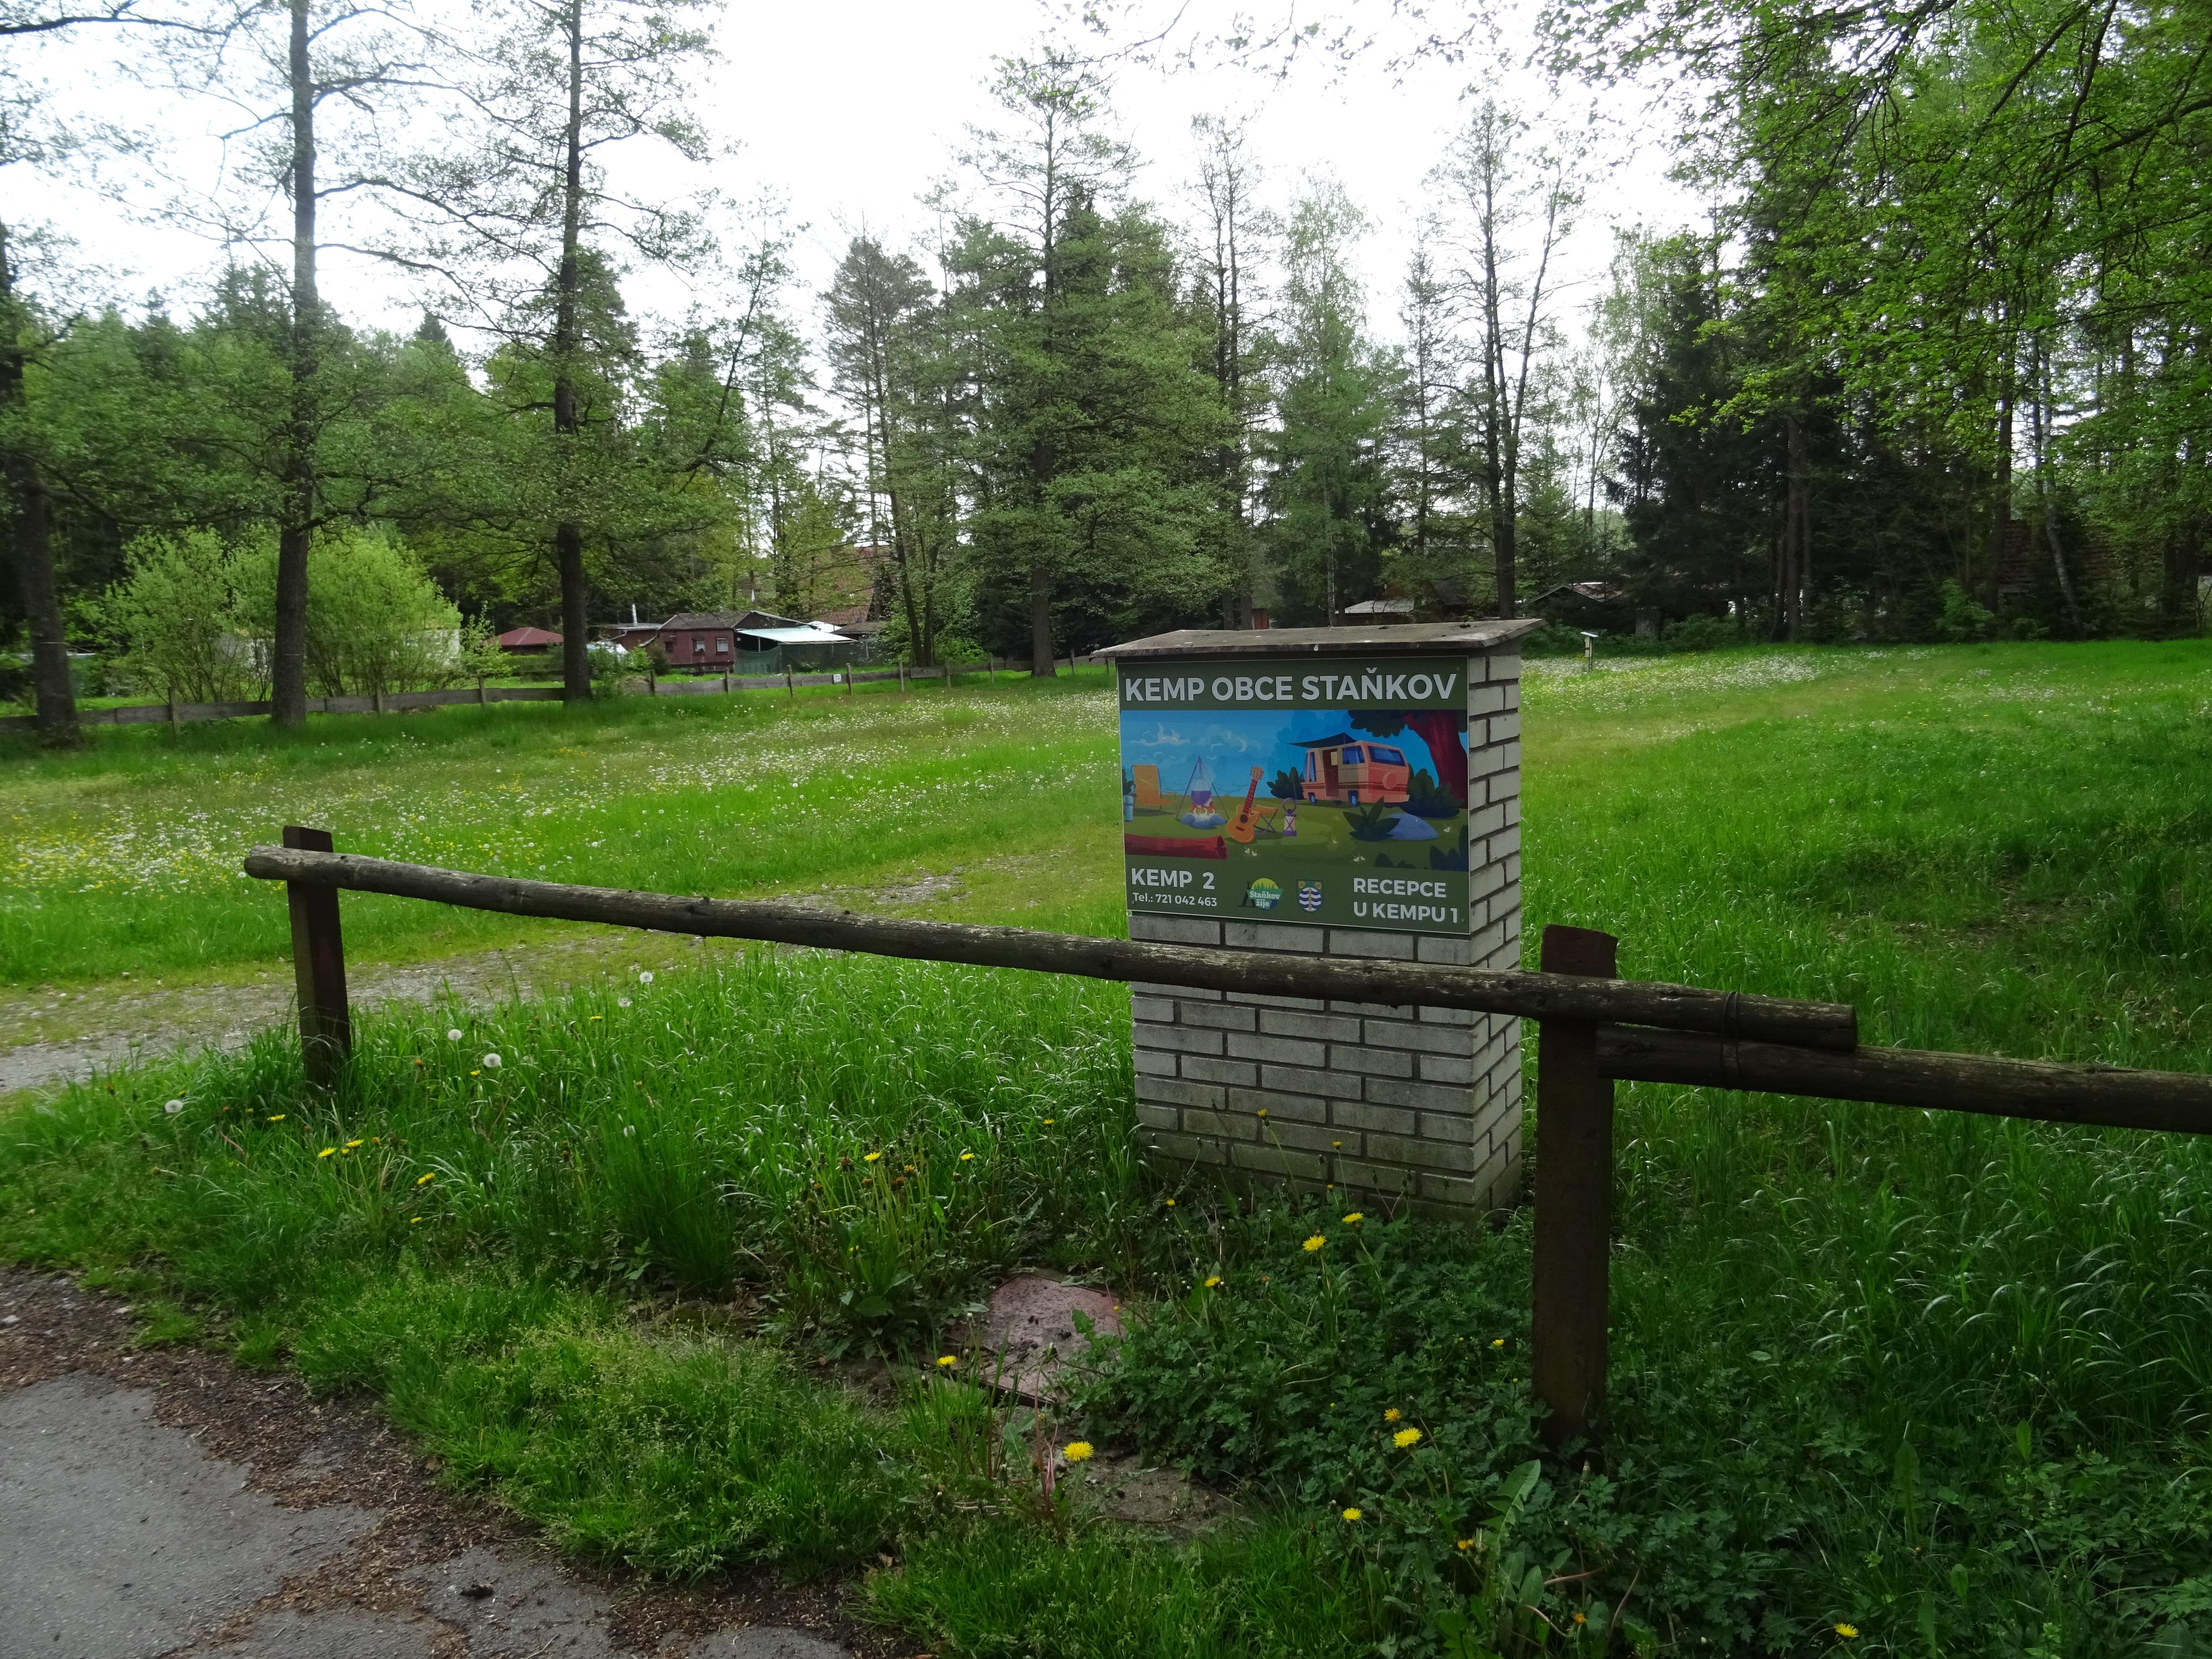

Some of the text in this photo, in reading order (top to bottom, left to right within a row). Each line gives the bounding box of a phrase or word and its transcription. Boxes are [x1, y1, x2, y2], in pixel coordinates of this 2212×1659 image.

[1125, 667, 1457, 701] KEMP OBCE STAŇKOV
[1131, 868, 1215, 890] KEMP 2
[1353, 878, 1447, 898] RECEPCE
[1132, 892, 1217, 907] Tel.: 721 042 463
[1249, 890, 1280, 900] Staňkov
[1255, 899, 1270, 908] žije
[1353, 901, 1458, 923] U KEMPU 1
